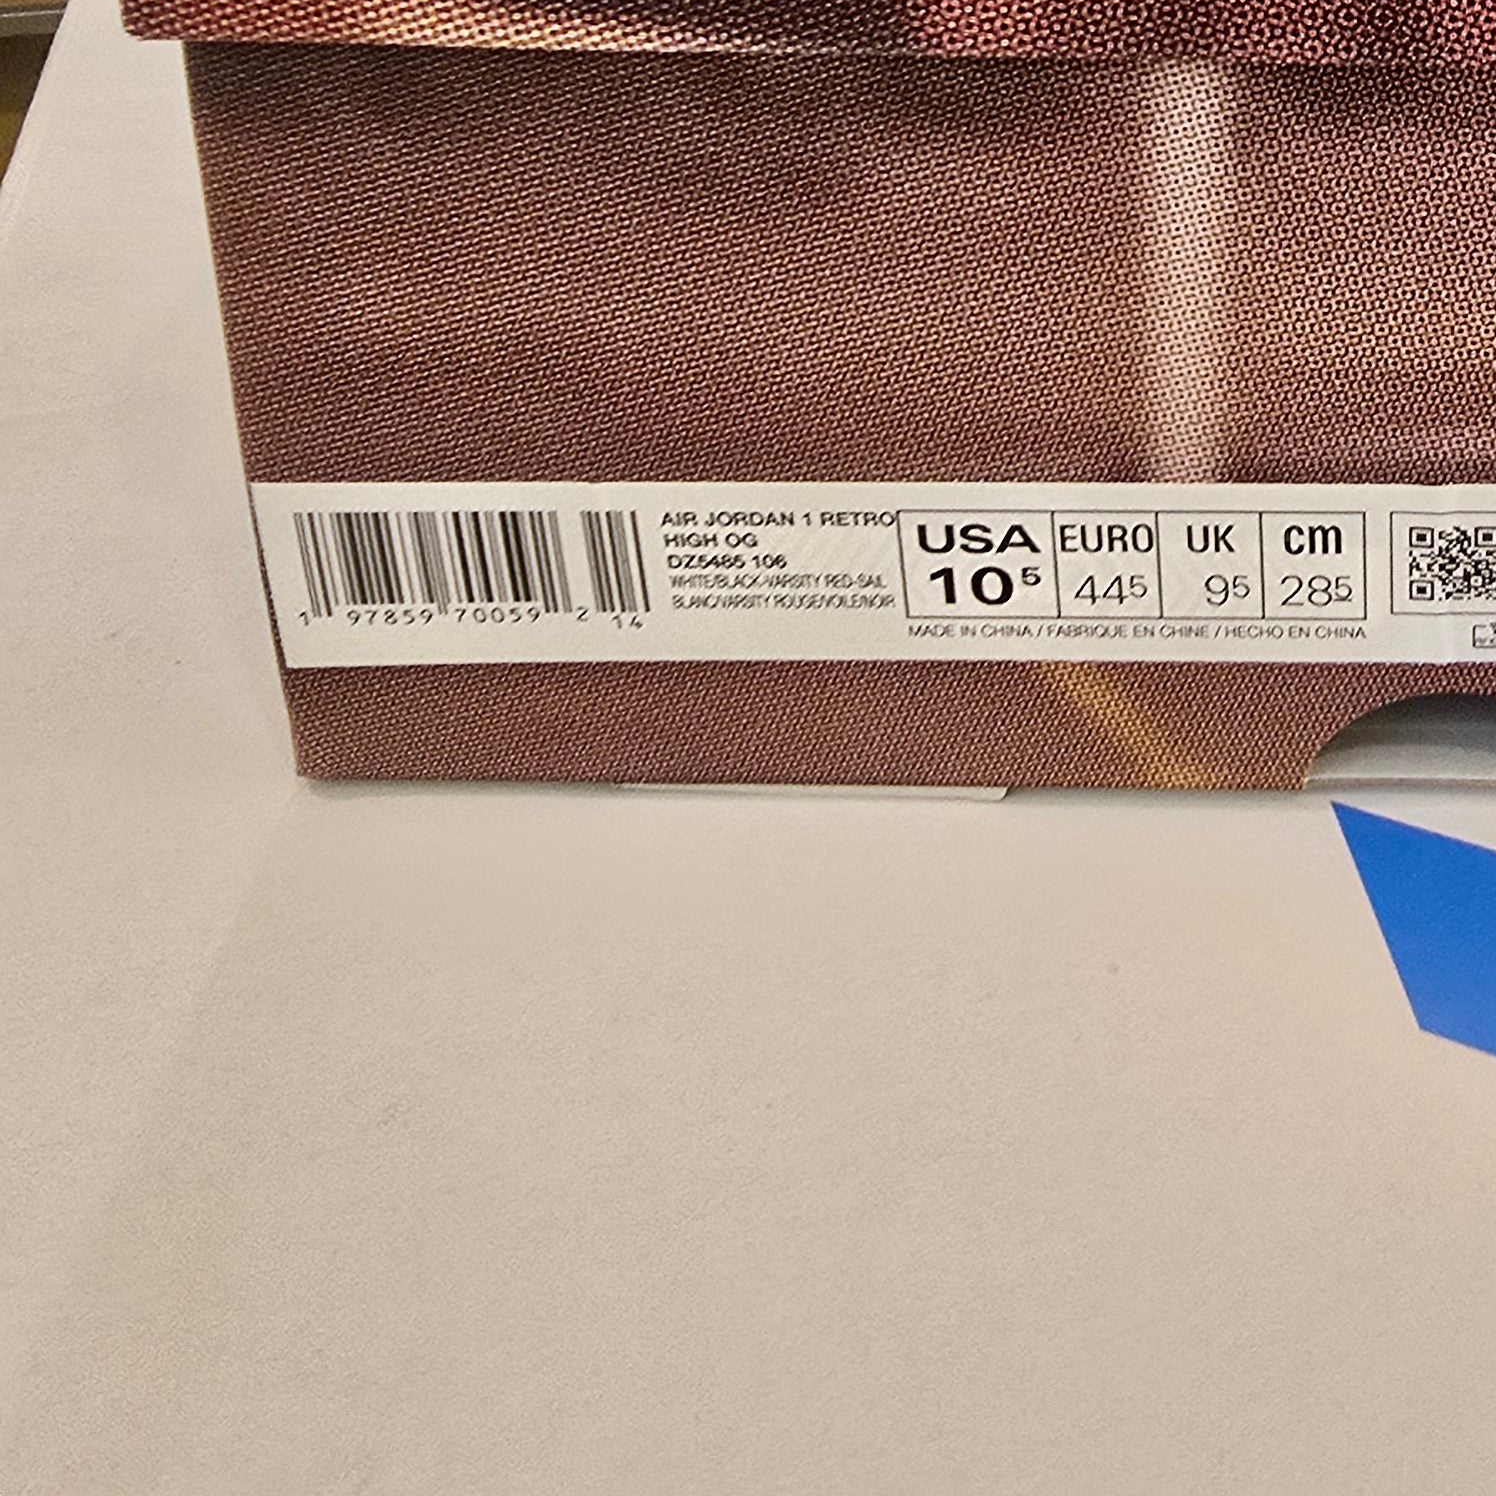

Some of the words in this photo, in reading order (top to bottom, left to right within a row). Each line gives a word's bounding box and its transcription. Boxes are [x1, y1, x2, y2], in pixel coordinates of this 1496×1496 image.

[660, 511, 698, 527] AIR
[704, 511, 796, 527] JORDAN
[802, 511, 813, 526] 1
[819, 511, 897, 527] RETRO
[663, 532, 718, 548] HIGH
[725, 532, 758, 548] OG
[917, 523, 1042, 554] USA
[1059, 523, 1154, 554] EURO
[1186, 524, 1236, 553] UK
[1283, 524, 1343, 555] cm
[667, 554, 746, 570] DZ5485
[752, 554, 788, 570] 106
[297, 610, 310, 627] 1
[347, 608, 435, 626] 97859
[454, 607, 541, 624] 70059
[575, 606, 589, 623] 2
[908, 624, 956, 638] MADE
[960, 624, 977, 638] IN
[980, 624, 1032, 638] CHINA
[1046, 624, 1129, 639] FABRIQUE
[1132, 624, 1155, 639] EN
[1159, 624, 1210, 639] CHINE
[1224, 625, 1284, 639] HECHO
[1288, 625, 1311, 639] EN
[1315, 625, 1368, 639] CHINA
